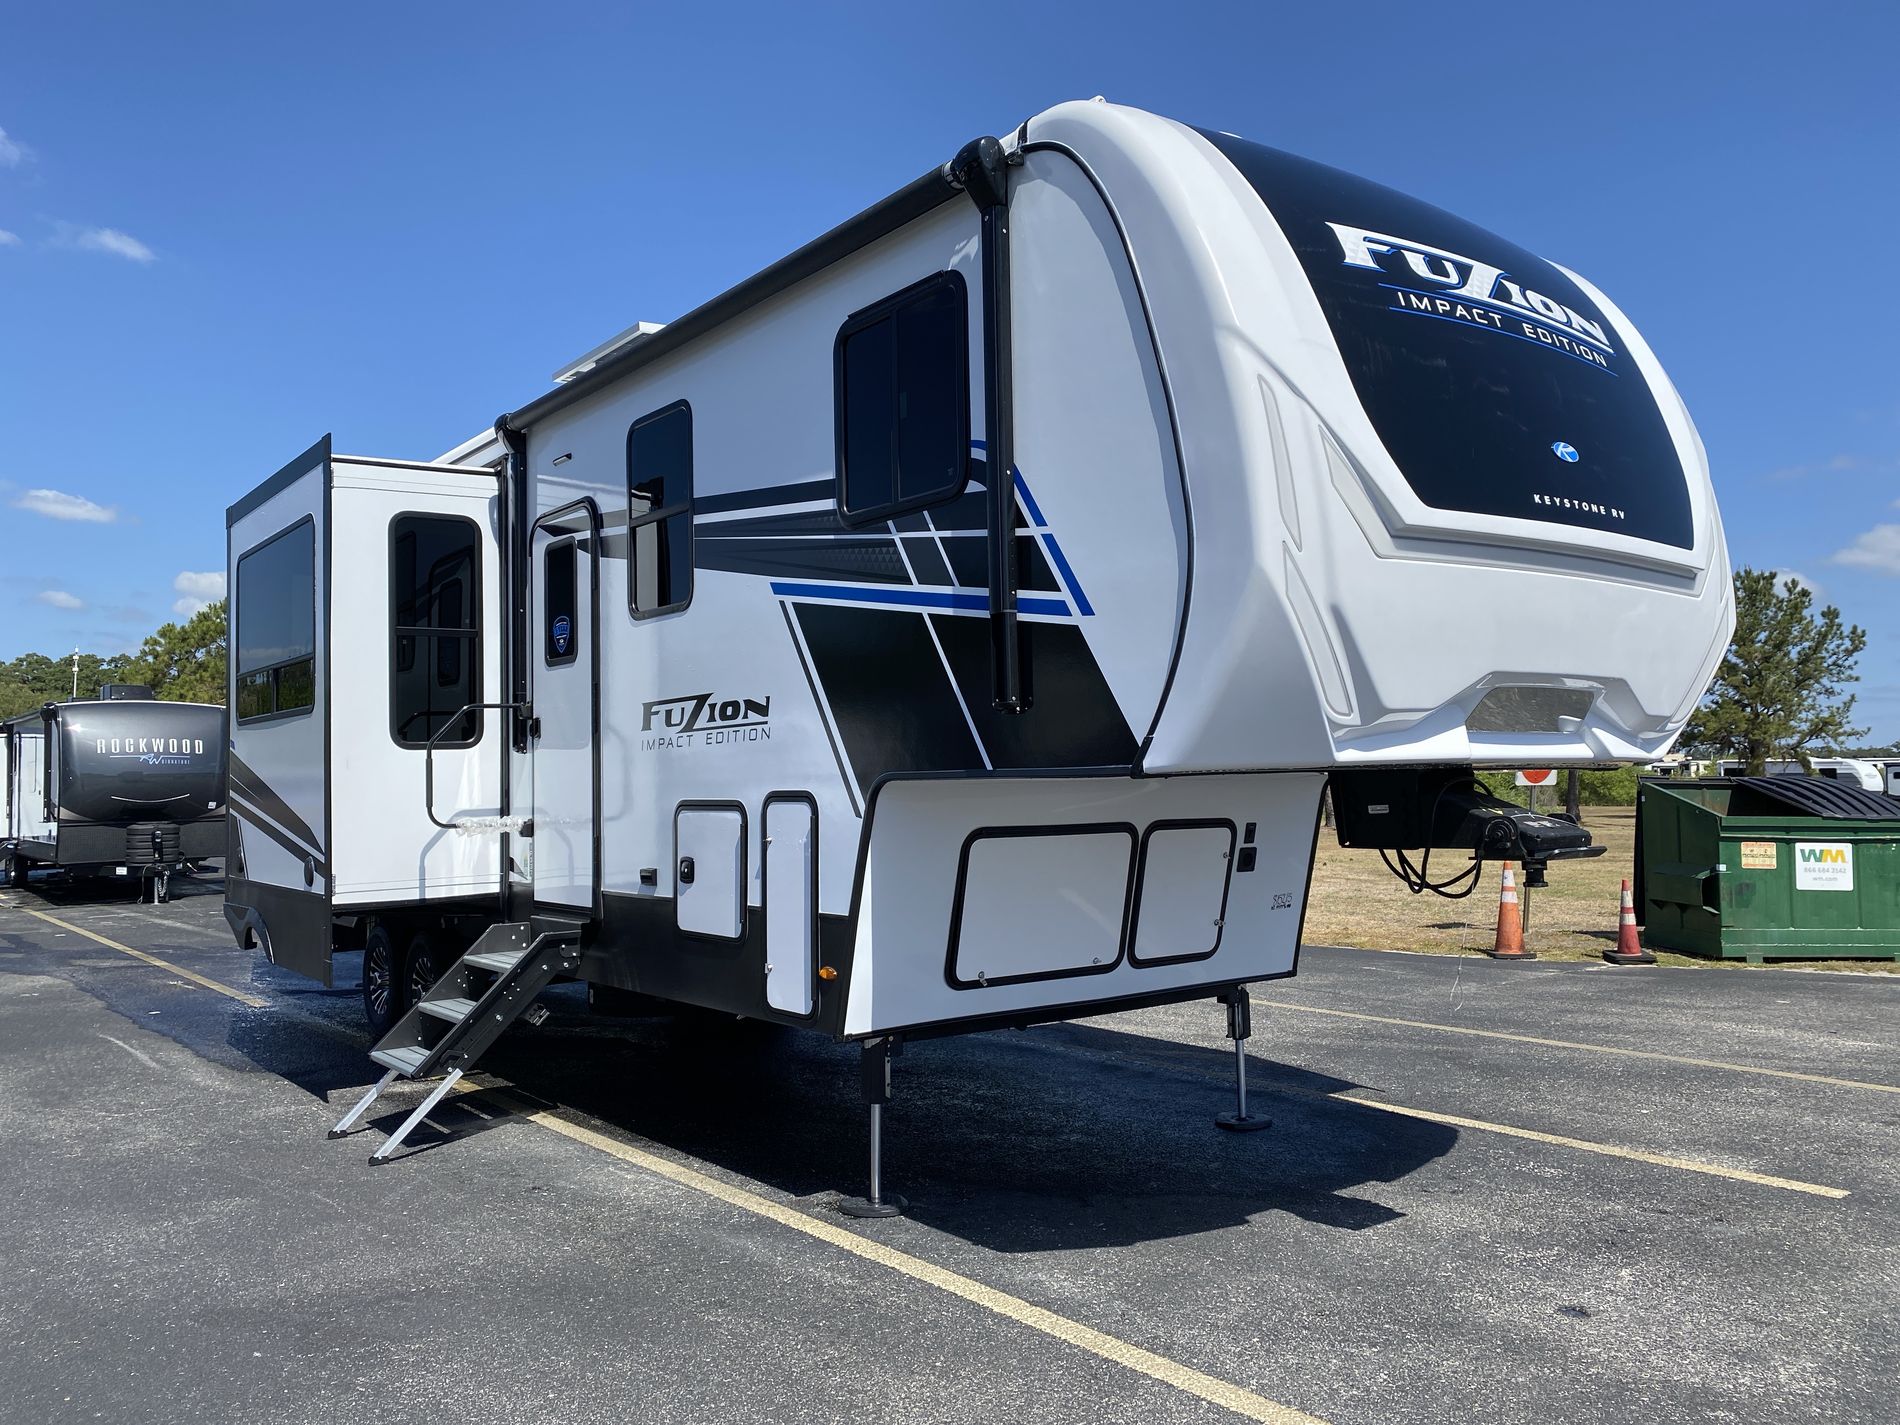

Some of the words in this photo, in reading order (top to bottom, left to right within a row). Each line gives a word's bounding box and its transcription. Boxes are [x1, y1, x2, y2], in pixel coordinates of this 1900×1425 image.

[1325, 222, 1611, 346] FUZION
[1398, 292, 1502, 328] IMPACT
[1524, 323, 1608, 368] EDITION
[1534, 494, 1606, 515] KEYSTONE
[1612, 508, 1625, 520] RV
[641, 692, 770, 733] FUZION
[97, 738, 203, 754] ROCKWOOD
[641, 734, 694, 751] IMPACT
[705, 727, 771, 745] EDITION
[1800, 848, 1847, 863] WM
